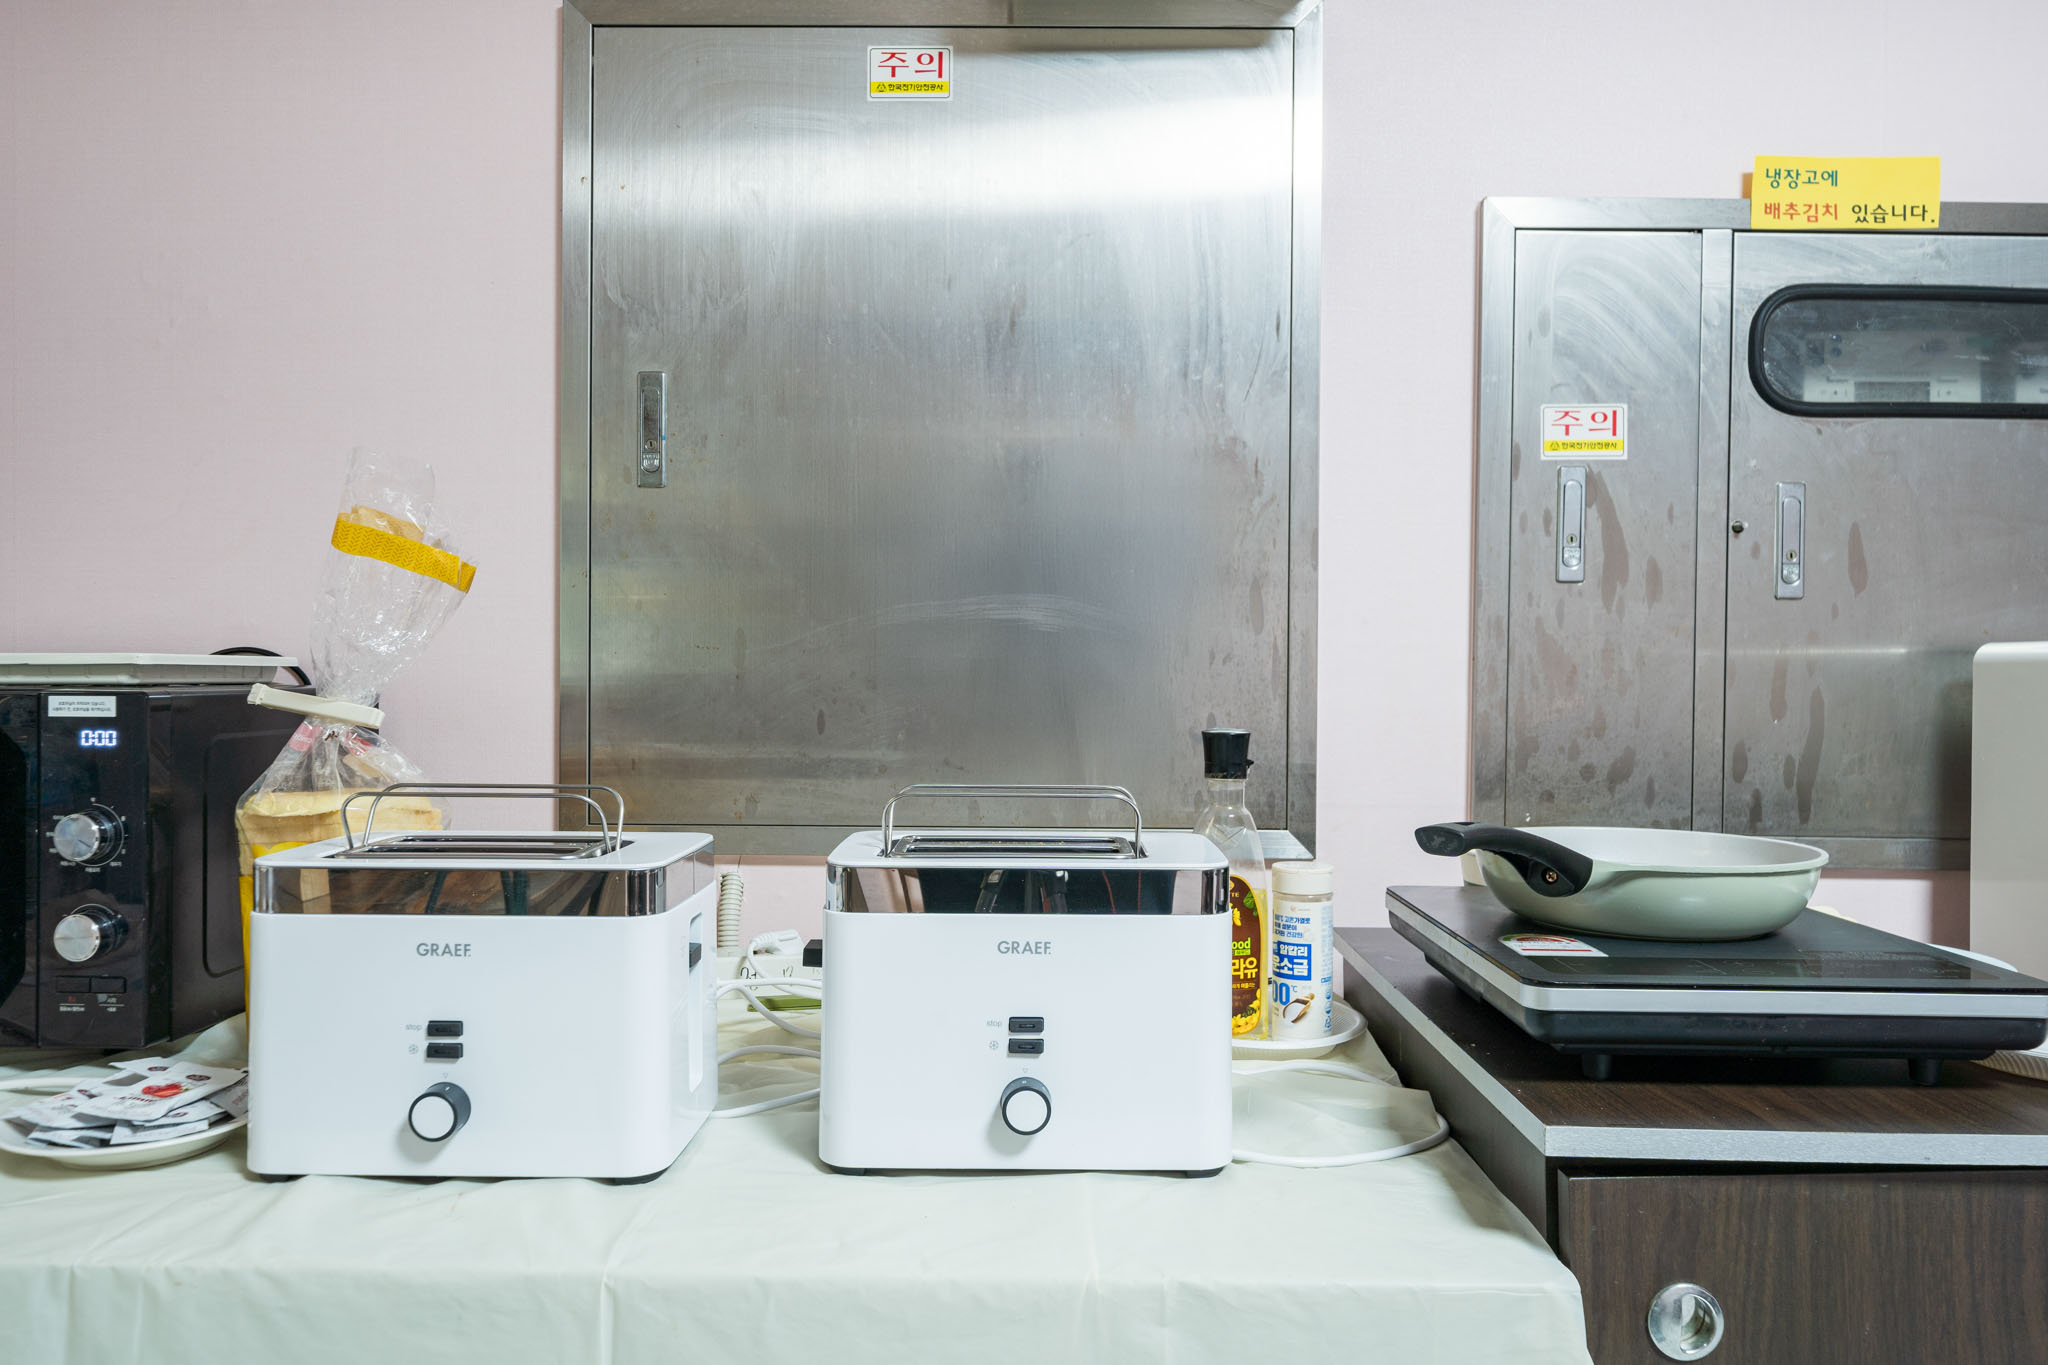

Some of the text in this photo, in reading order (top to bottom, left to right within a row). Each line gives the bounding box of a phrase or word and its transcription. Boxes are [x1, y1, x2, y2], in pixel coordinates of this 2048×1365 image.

[877, 51, 943, 79] 주의
[888, 83, 943, 91] 한국전기안전공사
[1765, 168, 1839, 190] 냉장고에
[1764, 202, 1936, 224] 배추김치 있습니다.
[1551, 409, 1617, 437] 주의
[80, 729, 117, 747] 0:00
[1231, 937, 1251, 950] ood
[1231, 957, 1258, 979] 라유
[1272, 955, 1309, 976] 운소금
